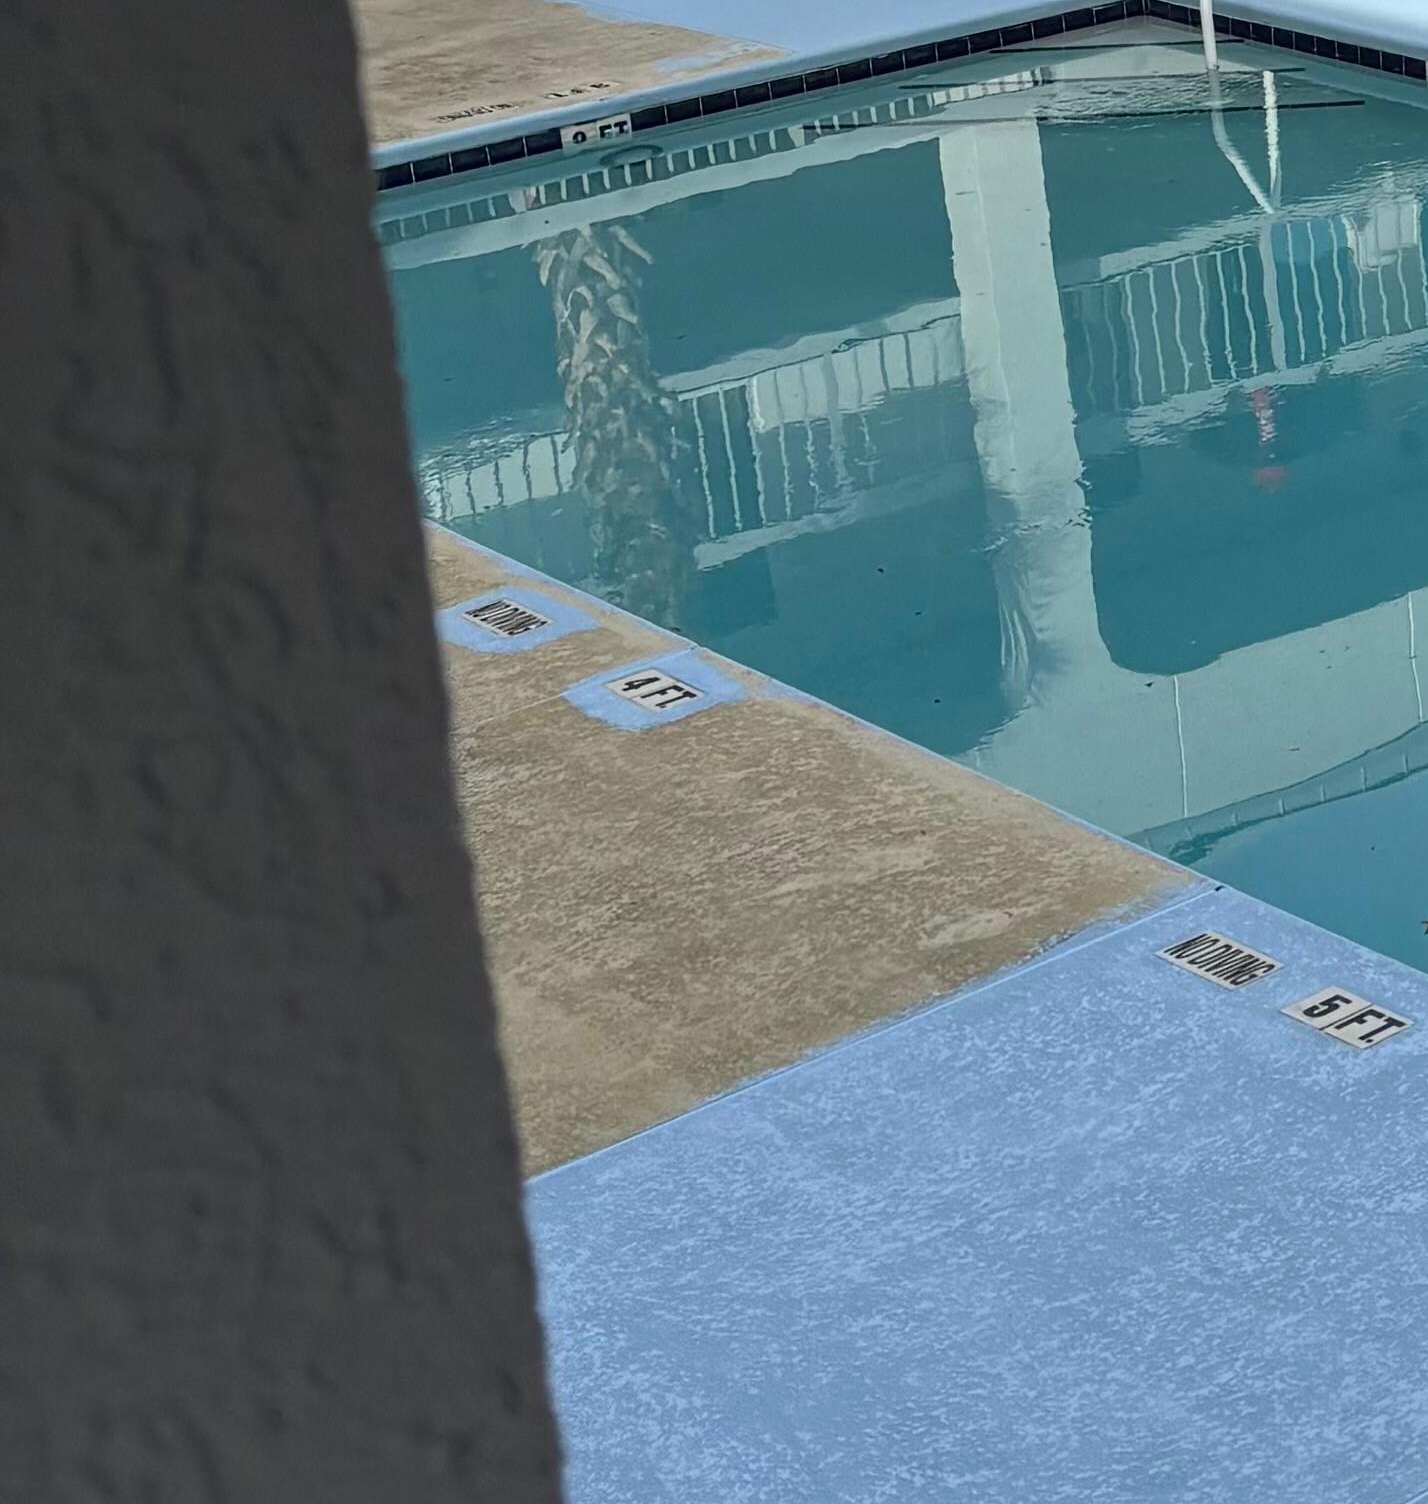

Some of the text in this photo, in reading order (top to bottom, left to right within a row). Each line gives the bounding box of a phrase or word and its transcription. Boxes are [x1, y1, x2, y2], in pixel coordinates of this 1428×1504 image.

[622, 677, 661, 691] 4
[1164, 933, 1276, 986] NO DIVING
[1303, 994, 1353, 1018] 5
